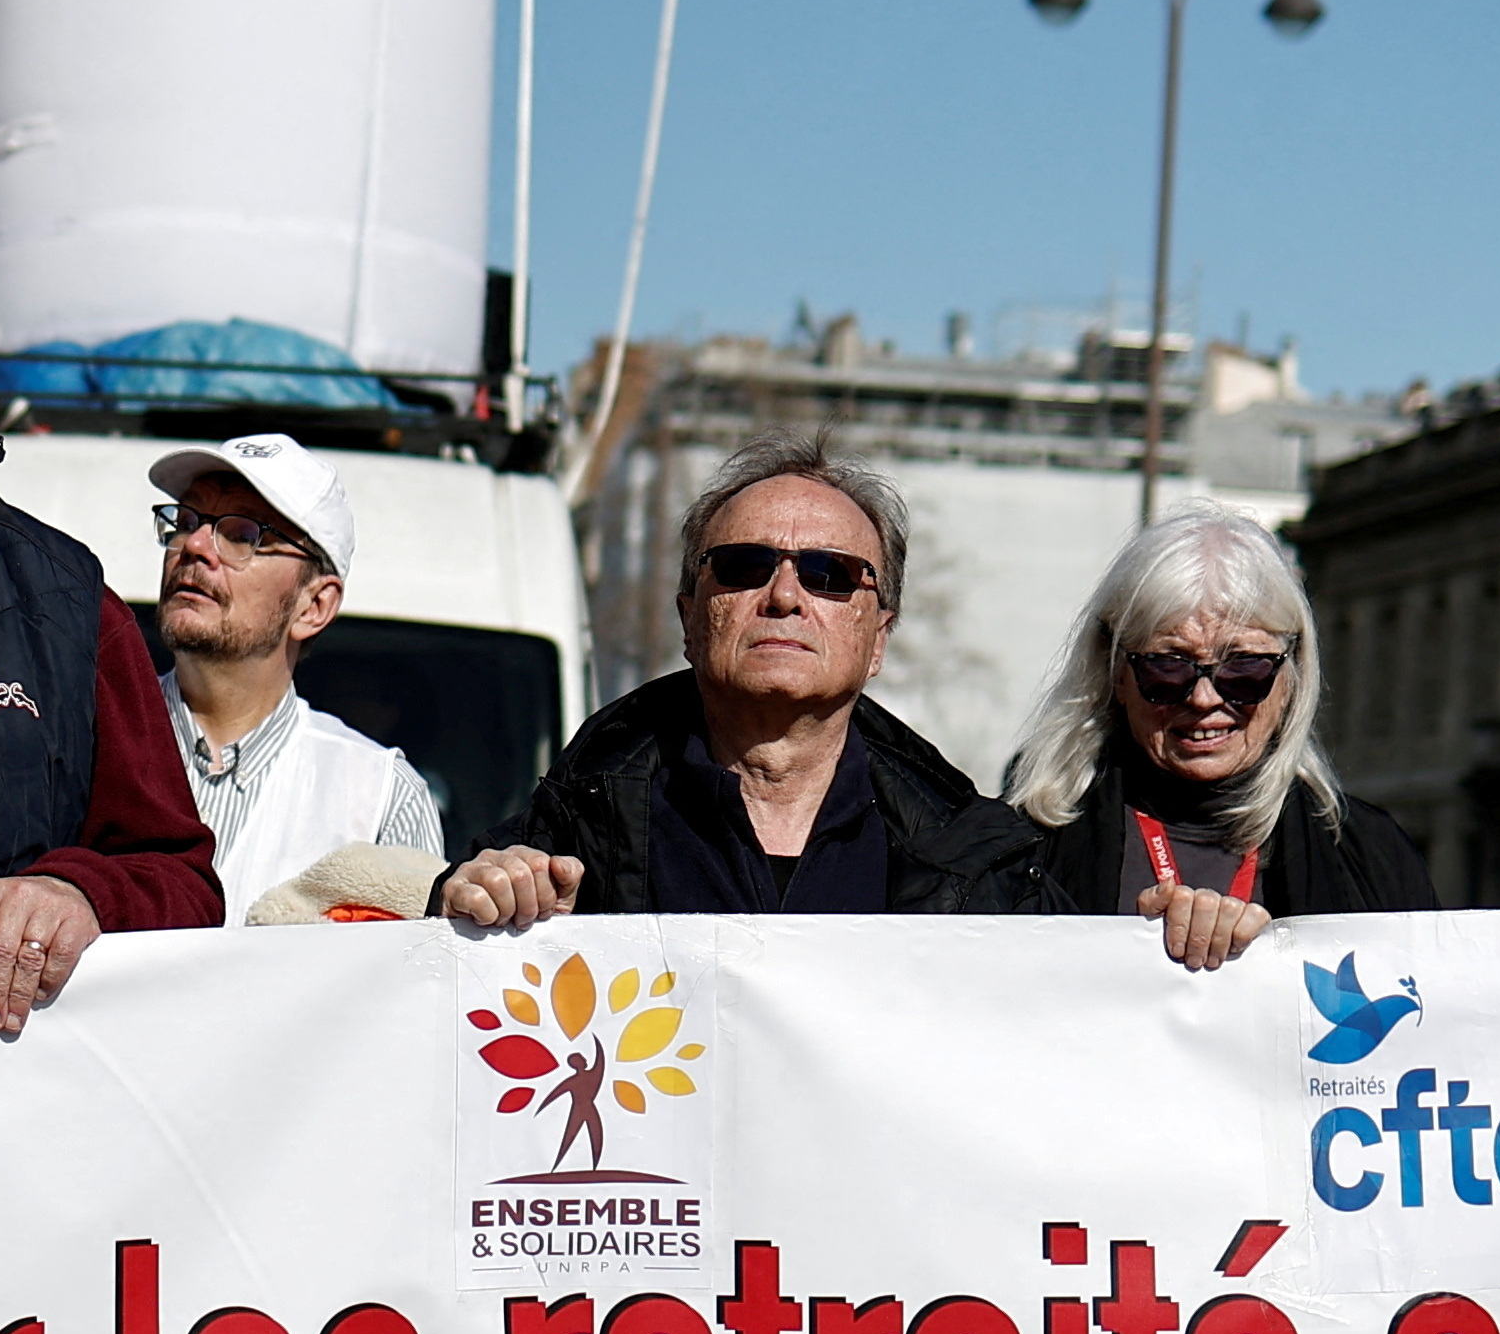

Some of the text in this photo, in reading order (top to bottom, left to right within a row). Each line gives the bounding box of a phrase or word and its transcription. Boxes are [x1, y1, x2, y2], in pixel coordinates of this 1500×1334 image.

[1151, 835, 1169, 867] POLICE
[1309, 1075, 1386, 1097] Retraités
[472, 1198, 701, 1227] ENSEMBLE
[472, 1231, 701, 1257] & SOLIDAIRES
